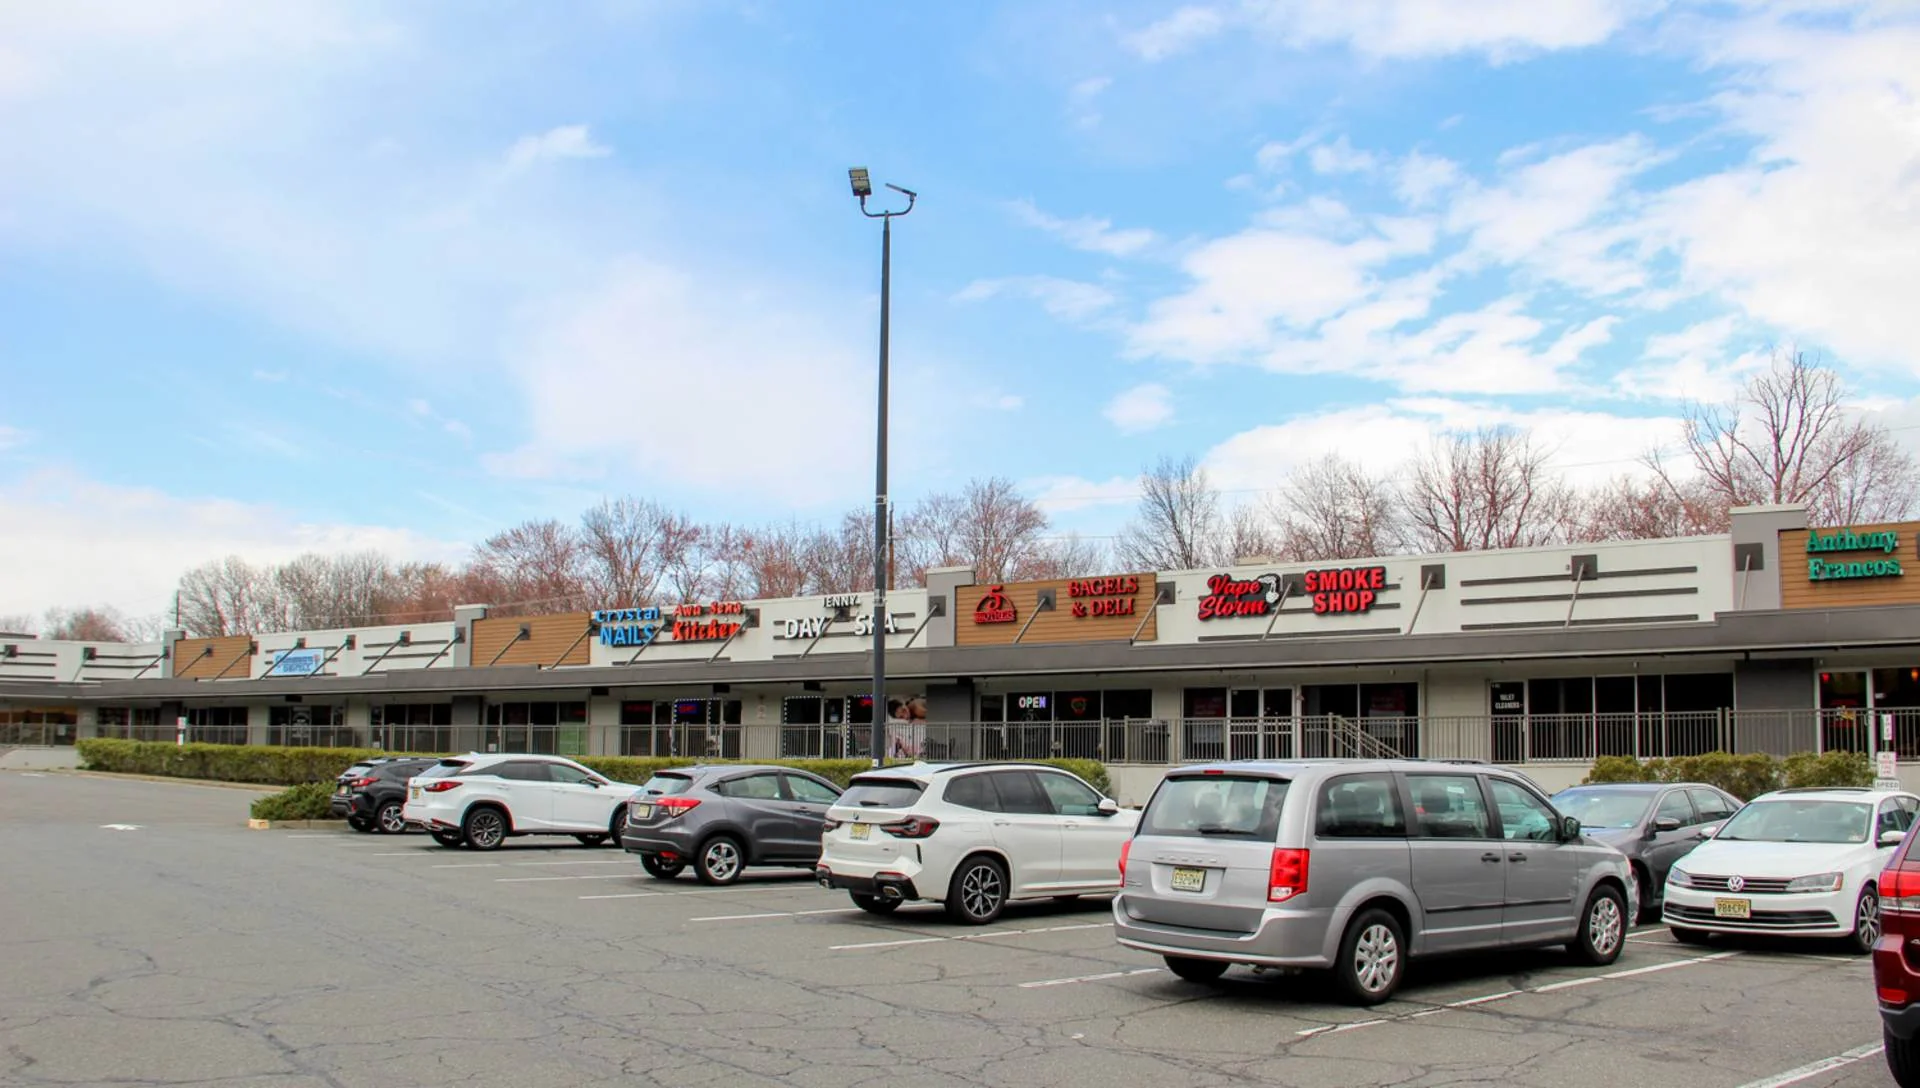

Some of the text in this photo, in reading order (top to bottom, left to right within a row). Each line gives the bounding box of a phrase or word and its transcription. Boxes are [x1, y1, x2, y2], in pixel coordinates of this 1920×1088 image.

[1068, 577, 1138, 597] BAGELS
[1207, 575, 1260, 597] Vape
[1304, 567, 1384, 592] SMOKE
[1072, 598, 1134, 617] & DELI
[1198, 595, 1266, 620] Storm
[1313, 590, 1374, 612] SHOP
[595, 607, 659, 622] Crystal
[600, 624, 656, 646] NAILS
[785, 616, 826, 639] DAY
[1019, 696, 1046, 709] OPEN
